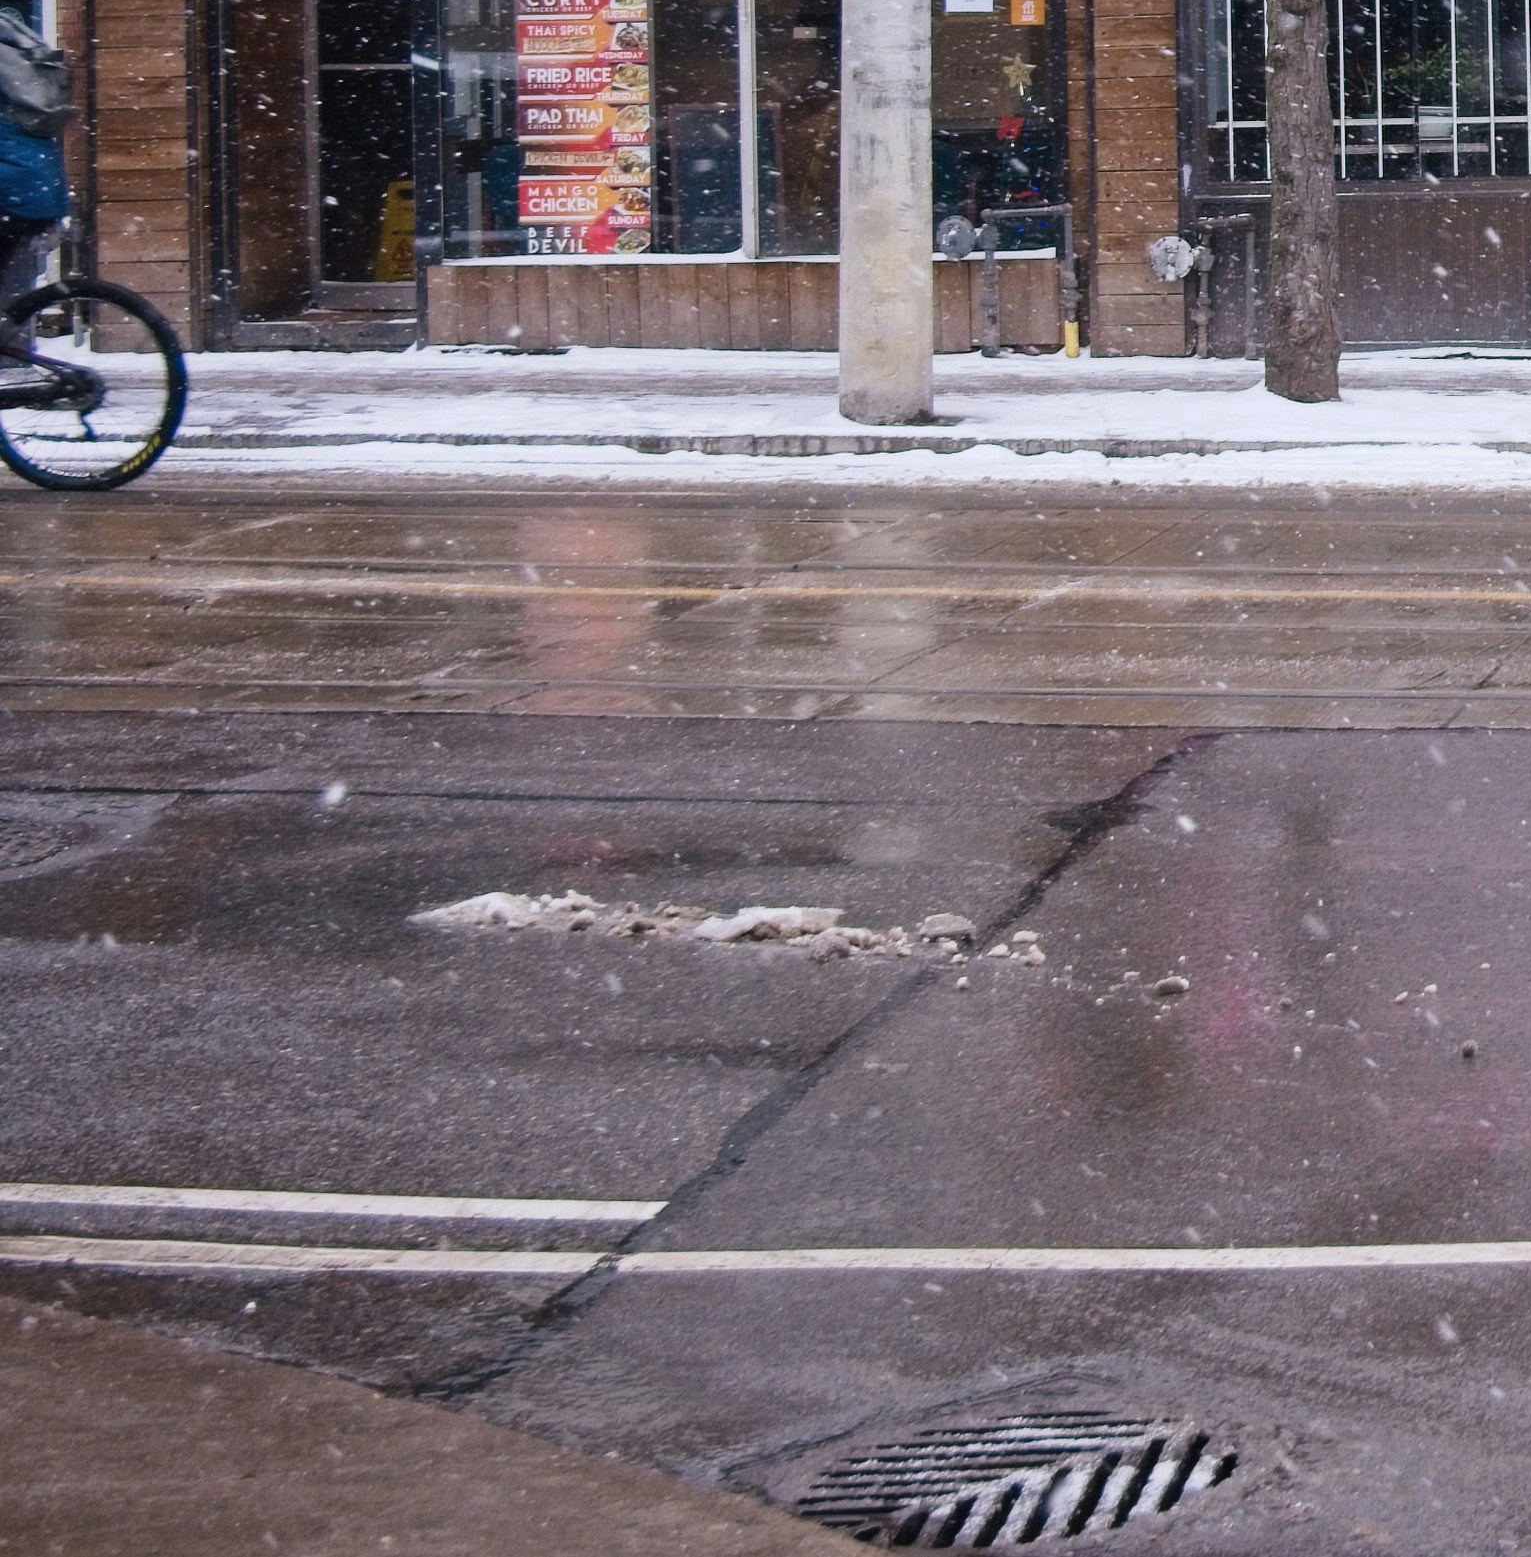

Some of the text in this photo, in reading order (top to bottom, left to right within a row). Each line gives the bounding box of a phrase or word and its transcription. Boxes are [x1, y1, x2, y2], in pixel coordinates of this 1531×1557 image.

[601, 9, 642, 19] TUESDAY
[598, 51, 644, 60] WEDNESDAY
[527, 67, 612, 84] FRIED RICE
[596, 91, 645, 101] THURSDAY
[527, 107, 604, 124] PAD THAI
[611, 132, 645, 143] FRIDAY
[596, 174, 646, 184] SATURDAY
[528, 185, 598, 197] MANGO
[528, 197, 599, 213] CHICKEN
[608, 215, 646, 225] SUNDAY
[528, 226, 589, 238] BEEF
[528, 238, 589, 254] DEVIL
